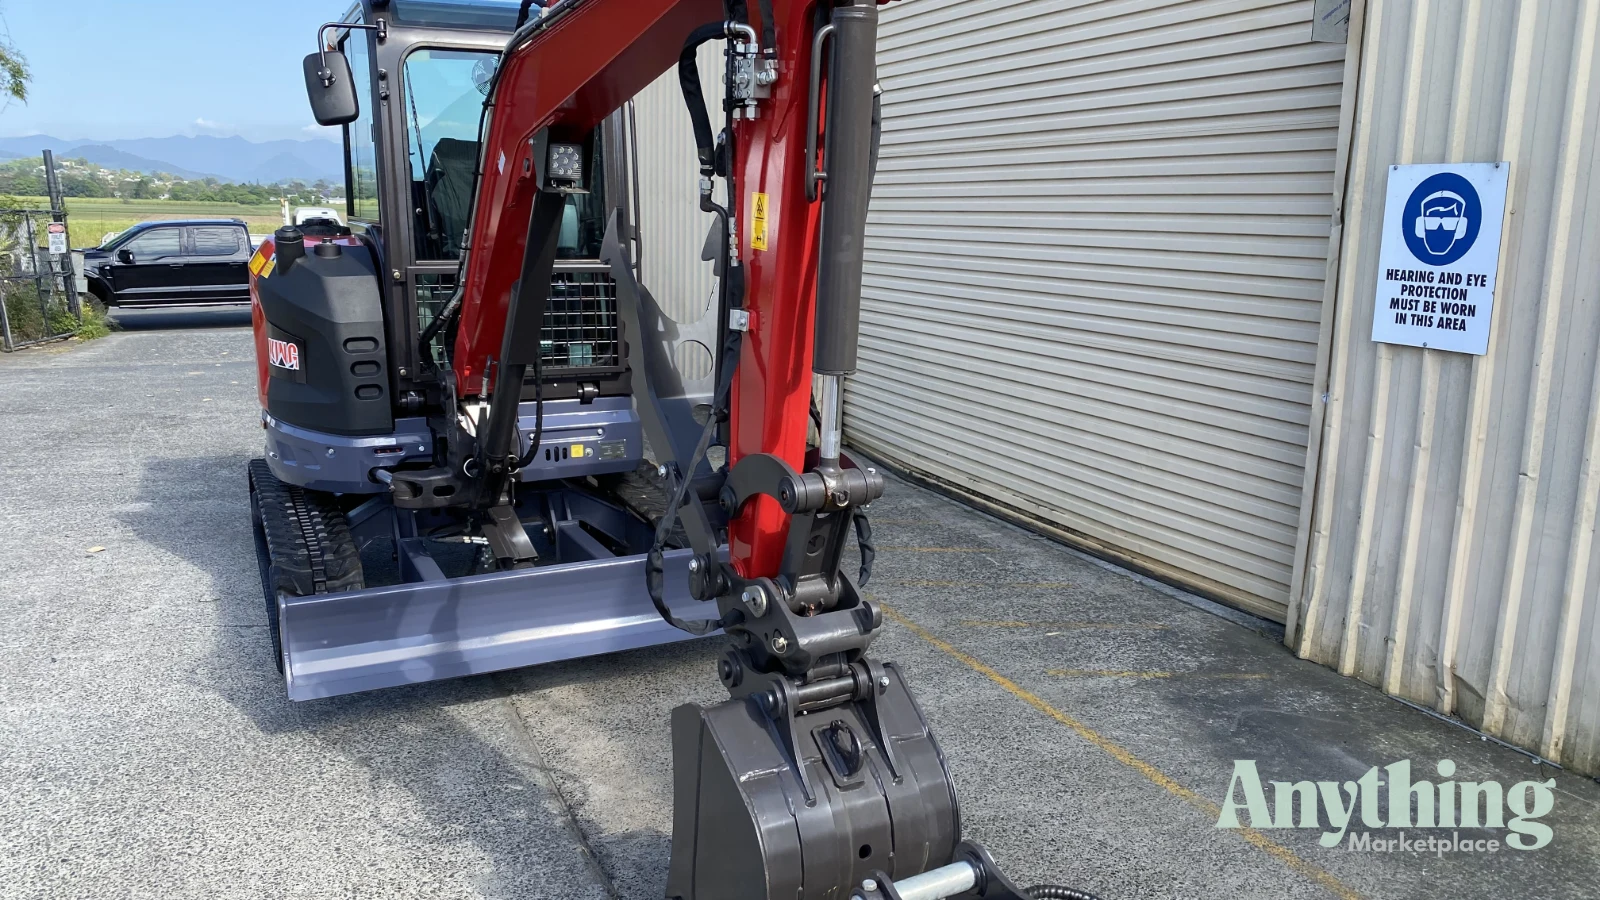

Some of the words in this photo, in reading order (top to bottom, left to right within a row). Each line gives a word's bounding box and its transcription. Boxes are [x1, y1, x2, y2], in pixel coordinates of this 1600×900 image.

[1386, 268, 1434, 283] HEARING
[1438, 272, 1462, 286] AND
[1466, 274, 1487, 287] EYE
[1401, 284, 1467, 301] PROTECTION
[1389, 298, 1420, 311] MUST
[1423, 300, 1436, 313] BE
[1441, 302, 1476, 317] WORN
[1395, 312, 1407, 325] IN
[1410, 314, 1433, 328] THIS
[1437, 317, 1466, 331] AREA
[268, 338, 299, 370] KING
